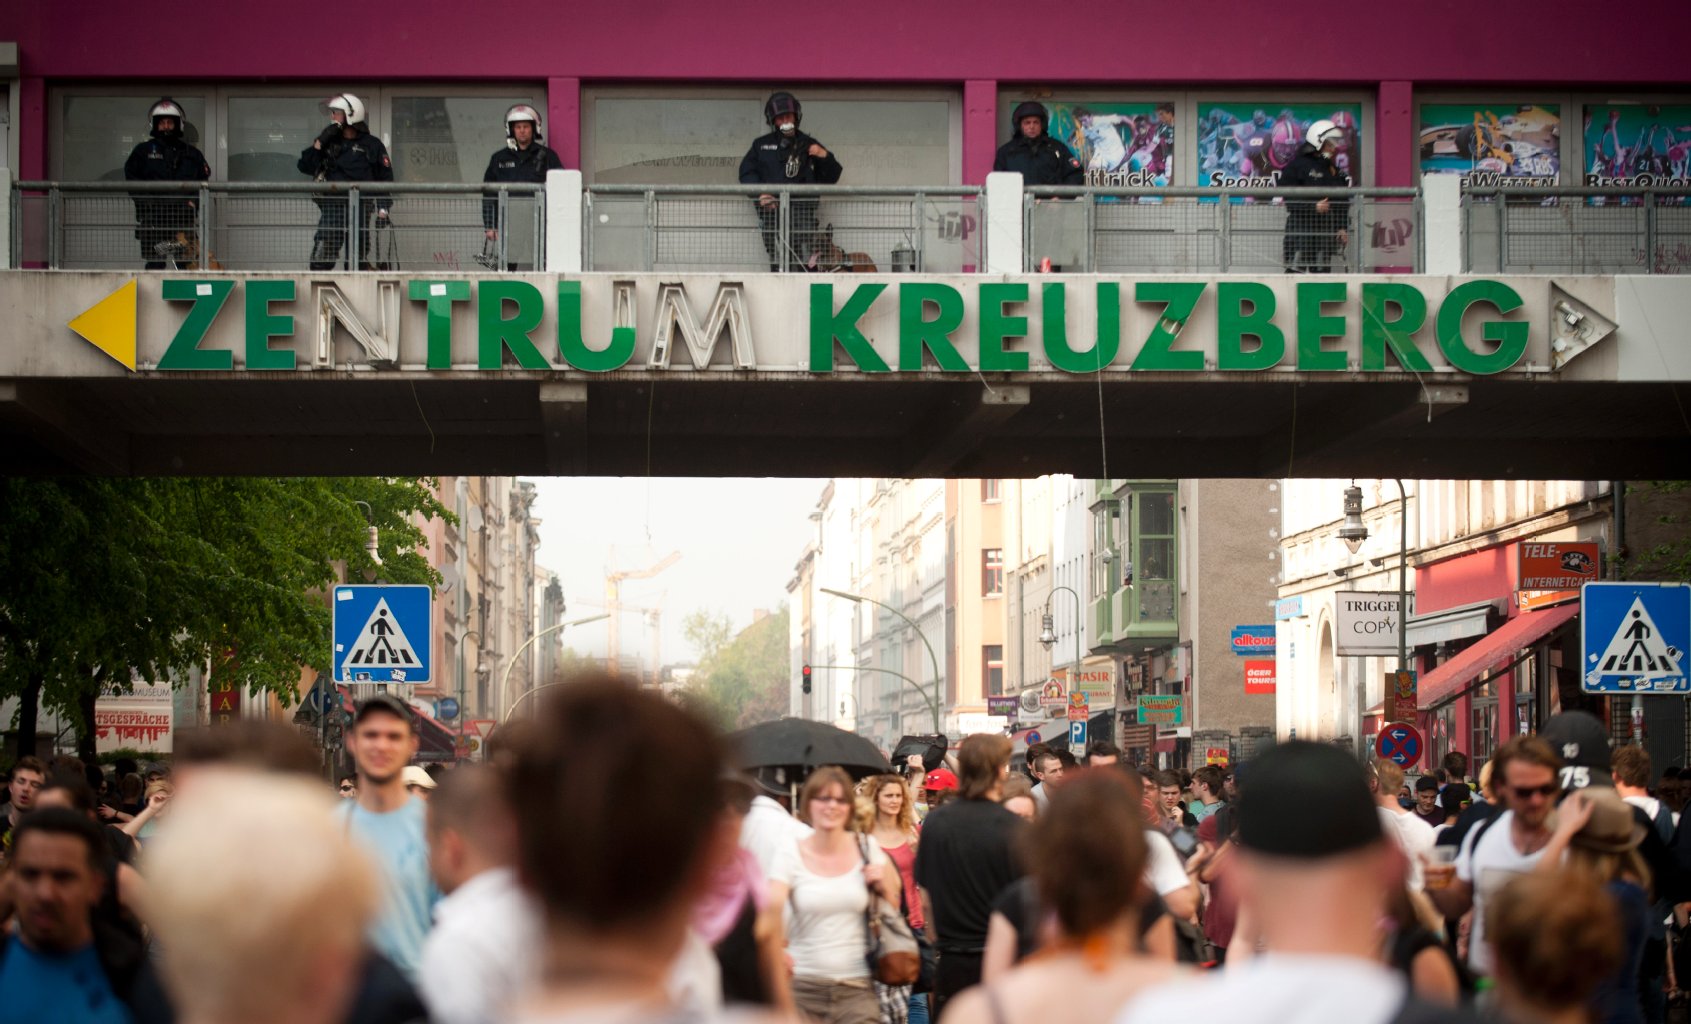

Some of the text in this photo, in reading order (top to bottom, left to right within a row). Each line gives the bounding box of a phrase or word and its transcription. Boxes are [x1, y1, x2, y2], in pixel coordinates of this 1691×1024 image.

[156, 279, 1531, 375] ZENTRUM KREUZBERG
[1524, 544, 1561, 558] TELE-
[1344, 600, 1401, 612] TRIGGE
[1353, 620, 1397, 634] COPY
[1072, 722, 1083, 744] P
[1559, 765, 1591, 790] 75
